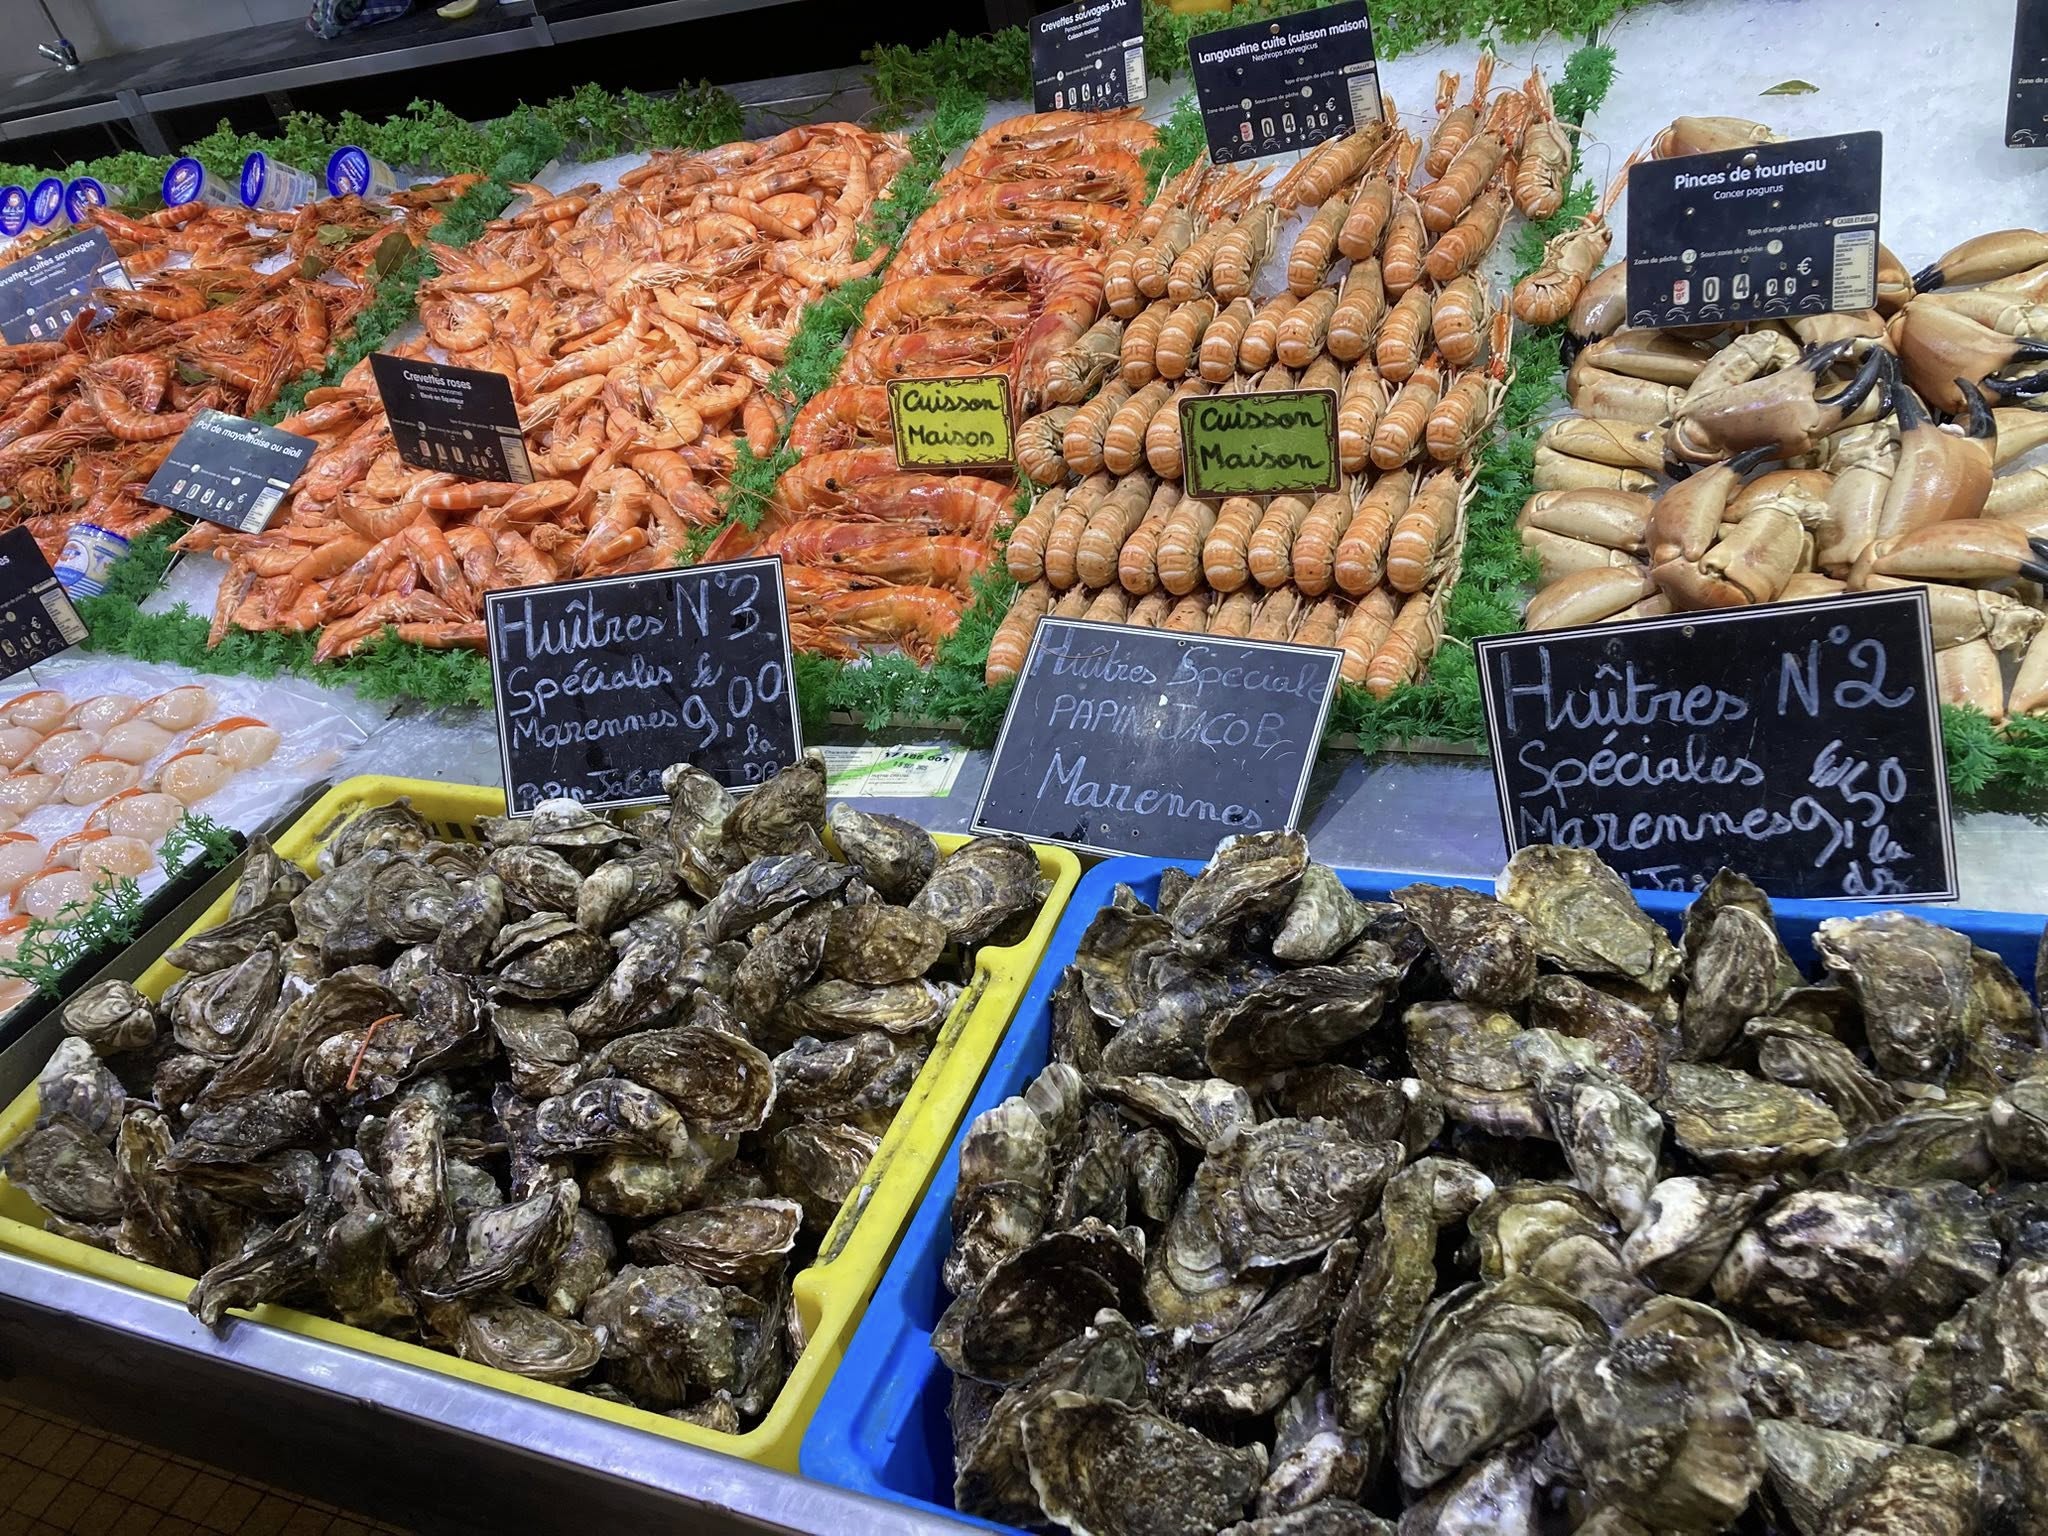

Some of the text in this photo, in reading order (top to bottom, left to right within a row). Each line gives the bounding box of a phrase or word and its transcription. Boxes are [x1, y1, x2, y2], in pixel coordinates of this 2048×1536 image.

[1040, 15, 1074, 33] Crevettes
[1074, 2, 1110, 22] sauvages
[1198, 16, 1368, 64] Langoustine cuite (cuisson maison)
[1252, 42, 1318, 63] Nephrops norvegicus
[1325, 97, 1336, 112] €
[1673, 158, 1827, 190] Pinces de tourteau
[1713, 184, 1784, 200] Cancer pagurus
[1747, 228, 1762, 237] Type
[29, 258, 54, 273] cuites
[54, 240, 96, 261] sauvages
[1634, 258, 1650, 266] Zone
[1650, 256, 1658, 264] de
[1797, 257, 1813, 276] €
[403, 370, 472, 390] Crevettes roses
[902, 389, 1000, 412] Cuisson
[1200, 405, 1323, 432] Cuisson
[196, 420, 211, 430] Pot
[211, 424, 222, 434] de
[222, 430, 270, 449] mayonnaise
[270, 443, 282, 452] ou
[908, 423, 996, 448] Maison
[1200, 443, 1325, 472] Maison
[497, 590, 667, 662] Huîtres
[1030, 625, 1157, 686] Huîtres
[507, 653, 674, 718] Spéciales
[1500, 645, 1750, 737] Huîtres
[513, 708, 679, 749] Marennes
[742, 723, 777, 756] la
[1519, 729, 1765, 809] Spéciales
[1037, 749, 1264, 830] Marennes
[1519, 804, 1792, 851] Marennes
[1868, 824, 1915, 864] la
